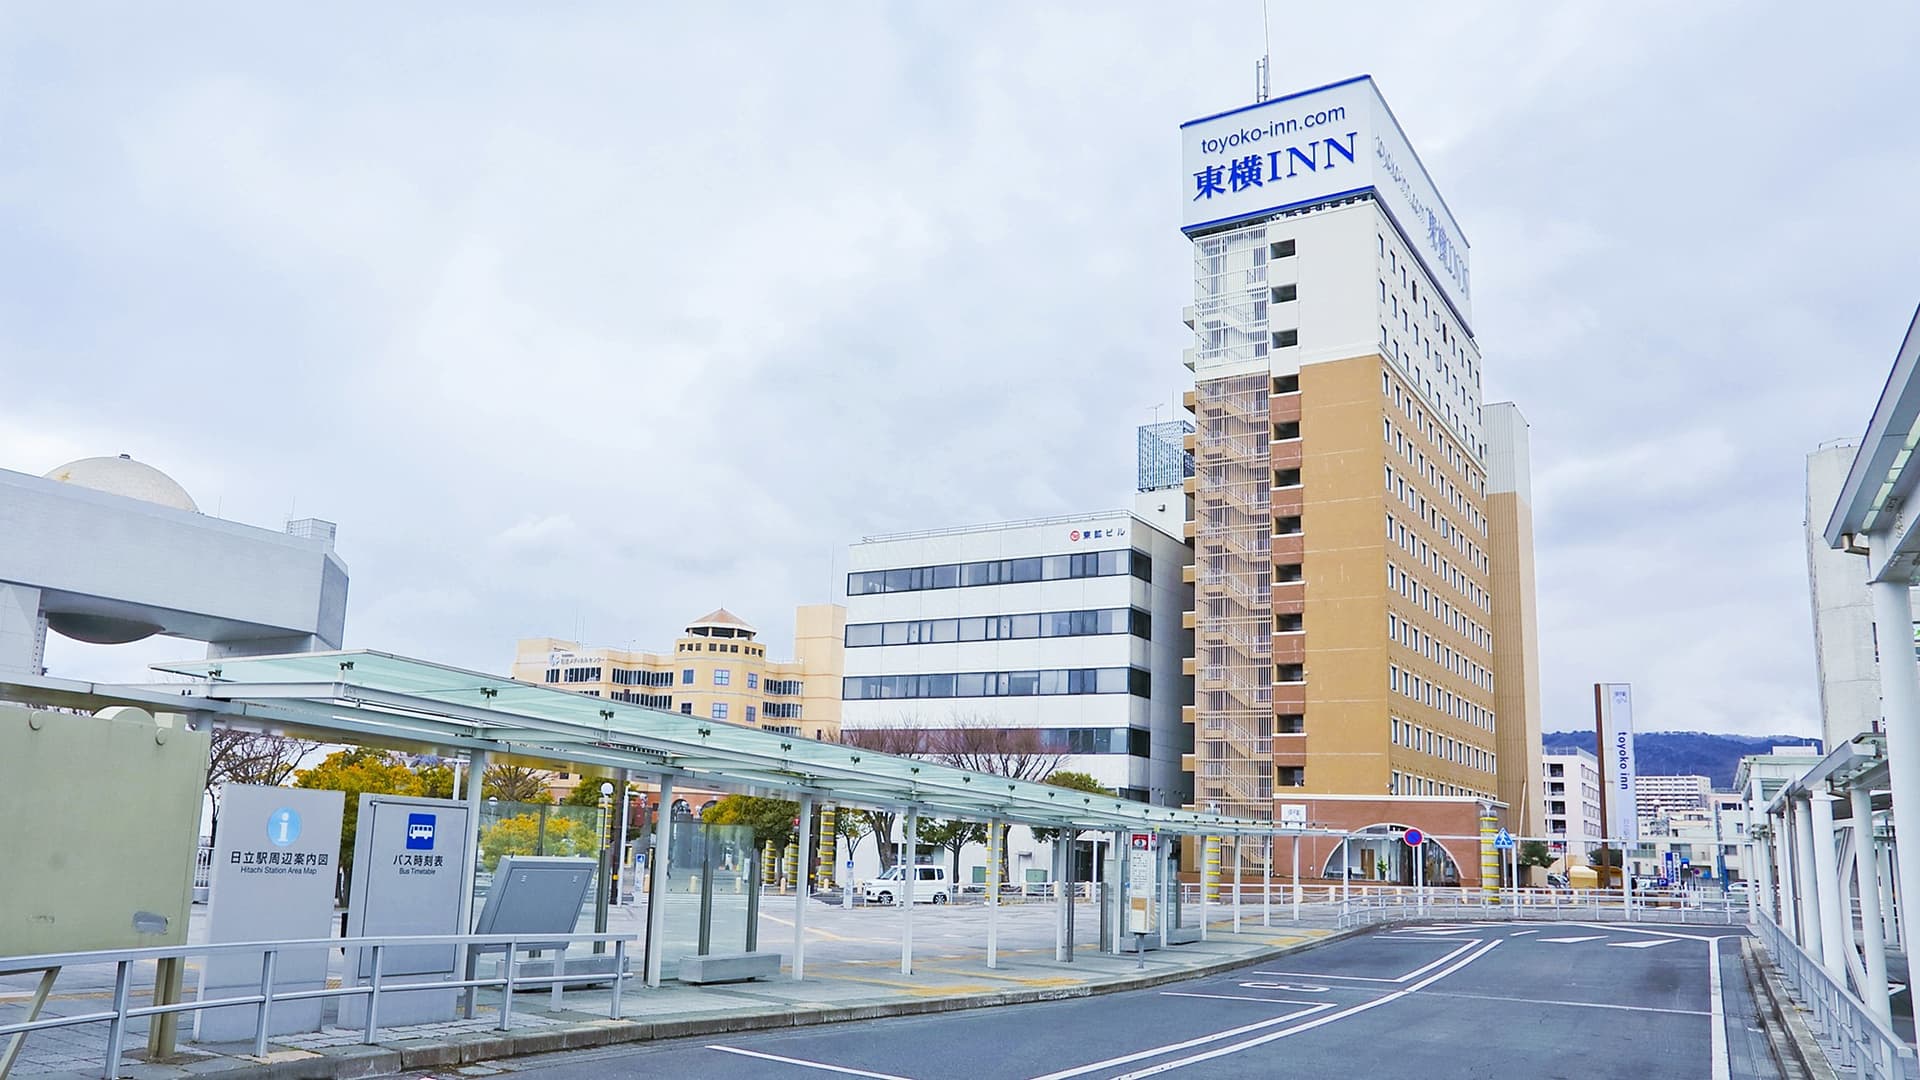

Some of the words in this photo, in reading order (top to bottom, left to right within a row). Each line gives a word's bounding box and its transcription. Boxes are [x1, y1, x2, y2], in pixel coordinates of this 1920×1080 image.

[1201, 106, 1346, 154] toyoko-inn.com
[1193, 131, 1358, 202] 東横INN
[1617, 731, 1629, 770] toyoko
[1620, 772, 1630, 790] inn
[230, 850, 329, 866] 日立駅周辺案内図
[393, 854, 444, 867] バス時刻表
[240, 866, 263, 874] Hitachi
[264, 866, 287, 874] Station
[287, 867, 302, 875] Area
[303, 867, 317, 875] Map
[399, 867, 410, 875] Bus
[411, 867, 436, 875] Timetable
